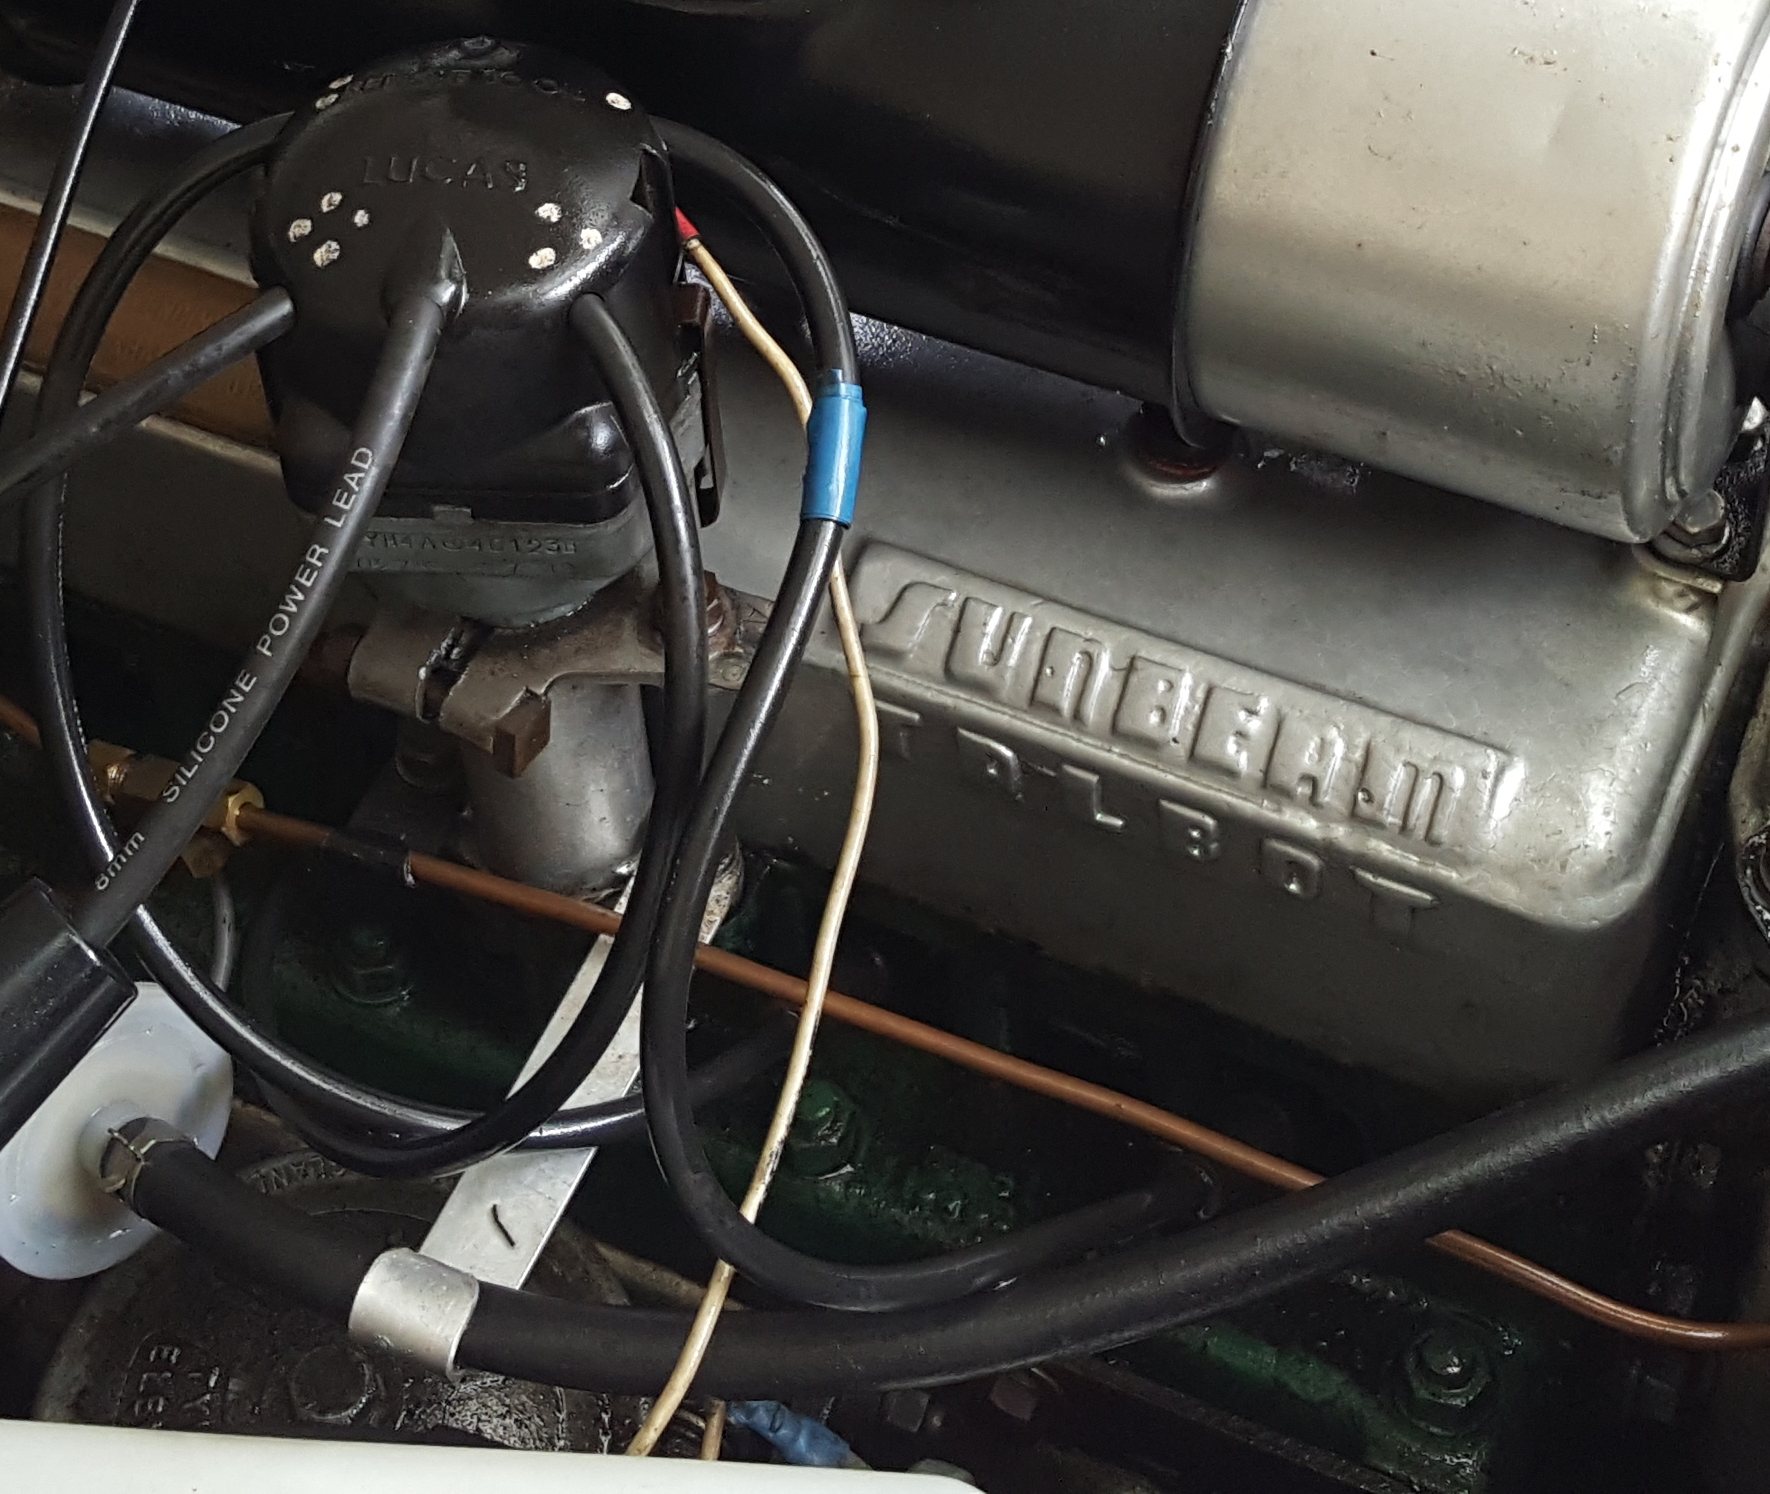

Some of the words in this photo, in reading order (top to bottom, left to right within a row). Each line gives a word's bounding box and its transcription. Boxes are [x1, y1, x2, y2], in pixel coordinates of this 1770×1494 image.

[363, 155, 528, 193] LUCAS
[94, 829, 146, 892] 8mm
[162, 668, 257, 804] SILICONE
[255, 543, 329, 658] POWER
[323, 446, 374, 529] LEAD
[861, 581, 1469, 847] SUNBEAM
[871, 698, 1439, 936] TALBOT
